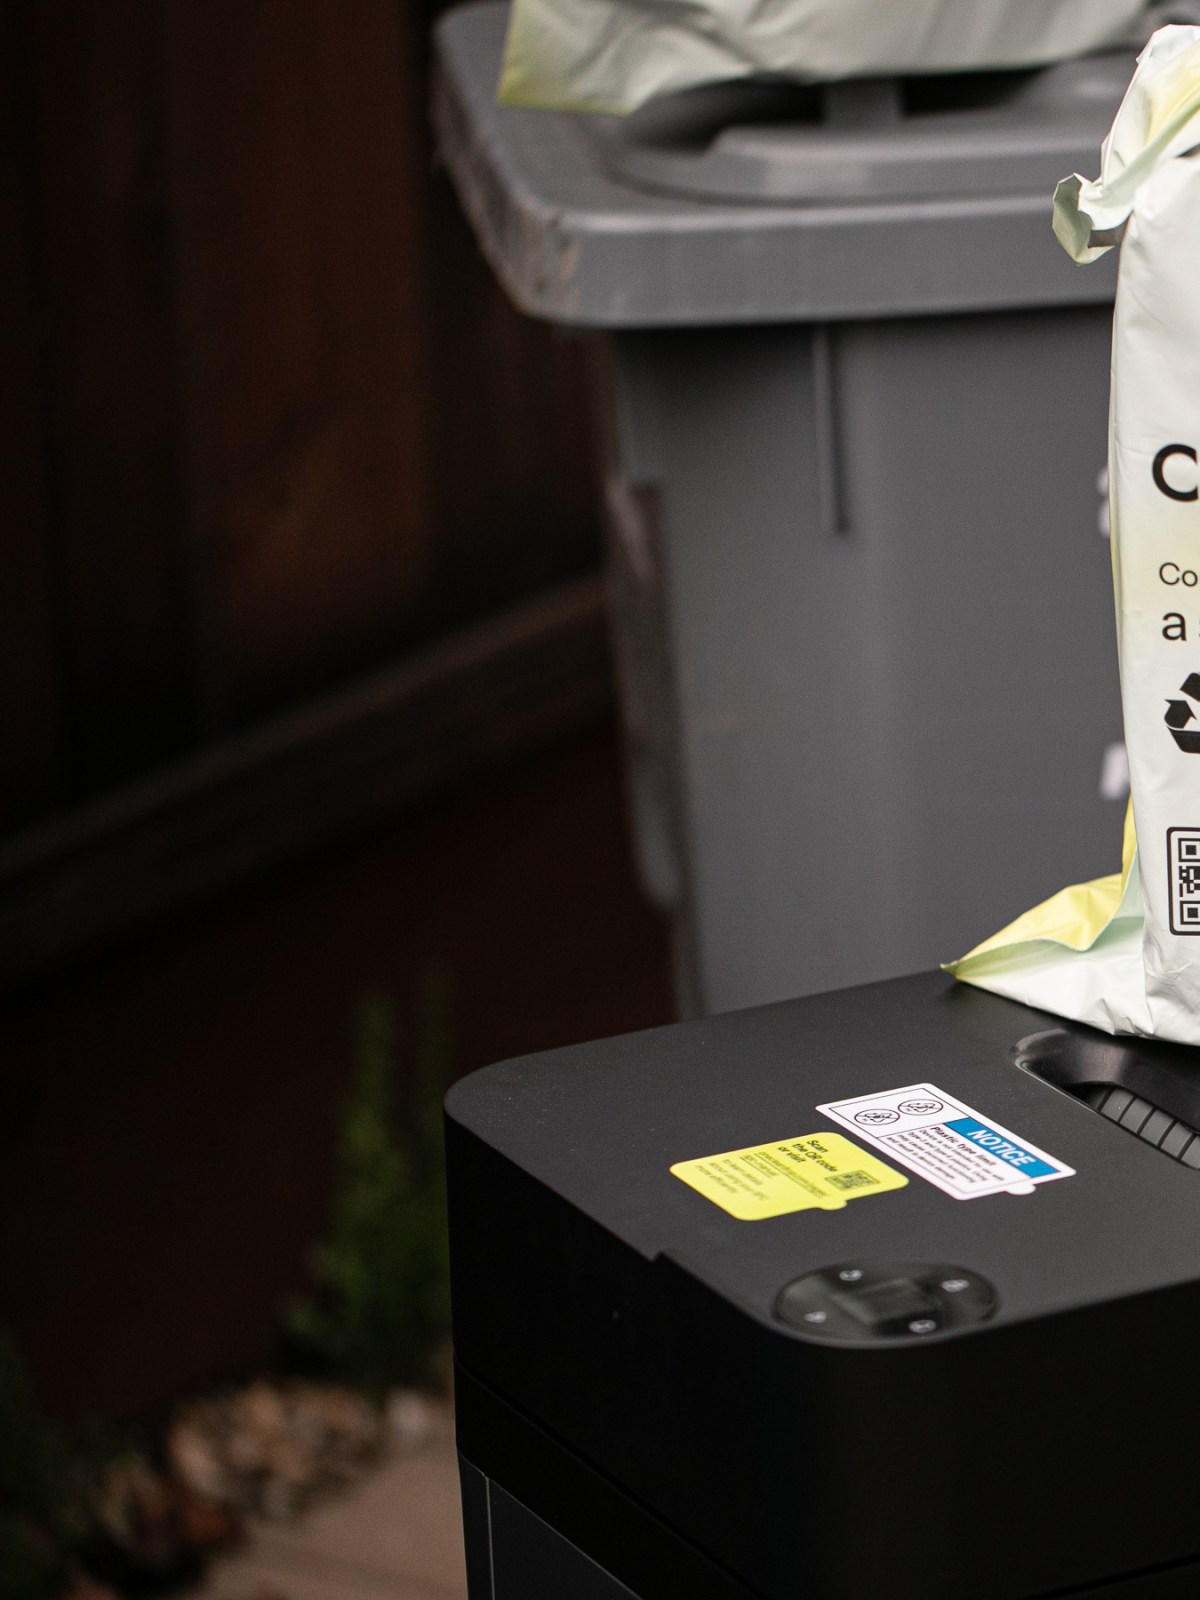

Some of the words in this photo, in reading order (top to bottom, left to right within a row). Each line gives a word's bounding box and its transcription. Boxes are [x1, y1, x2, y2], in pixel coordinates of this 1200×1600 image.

[1161, 611, 1187, 642] a
[806, 1139, 831, 1153] Scan
[930, 1126, 960, 1143] Plastic
[955, 1143, 977, 1155] type
[966, 1129, 1036, 1166] NOTICE
